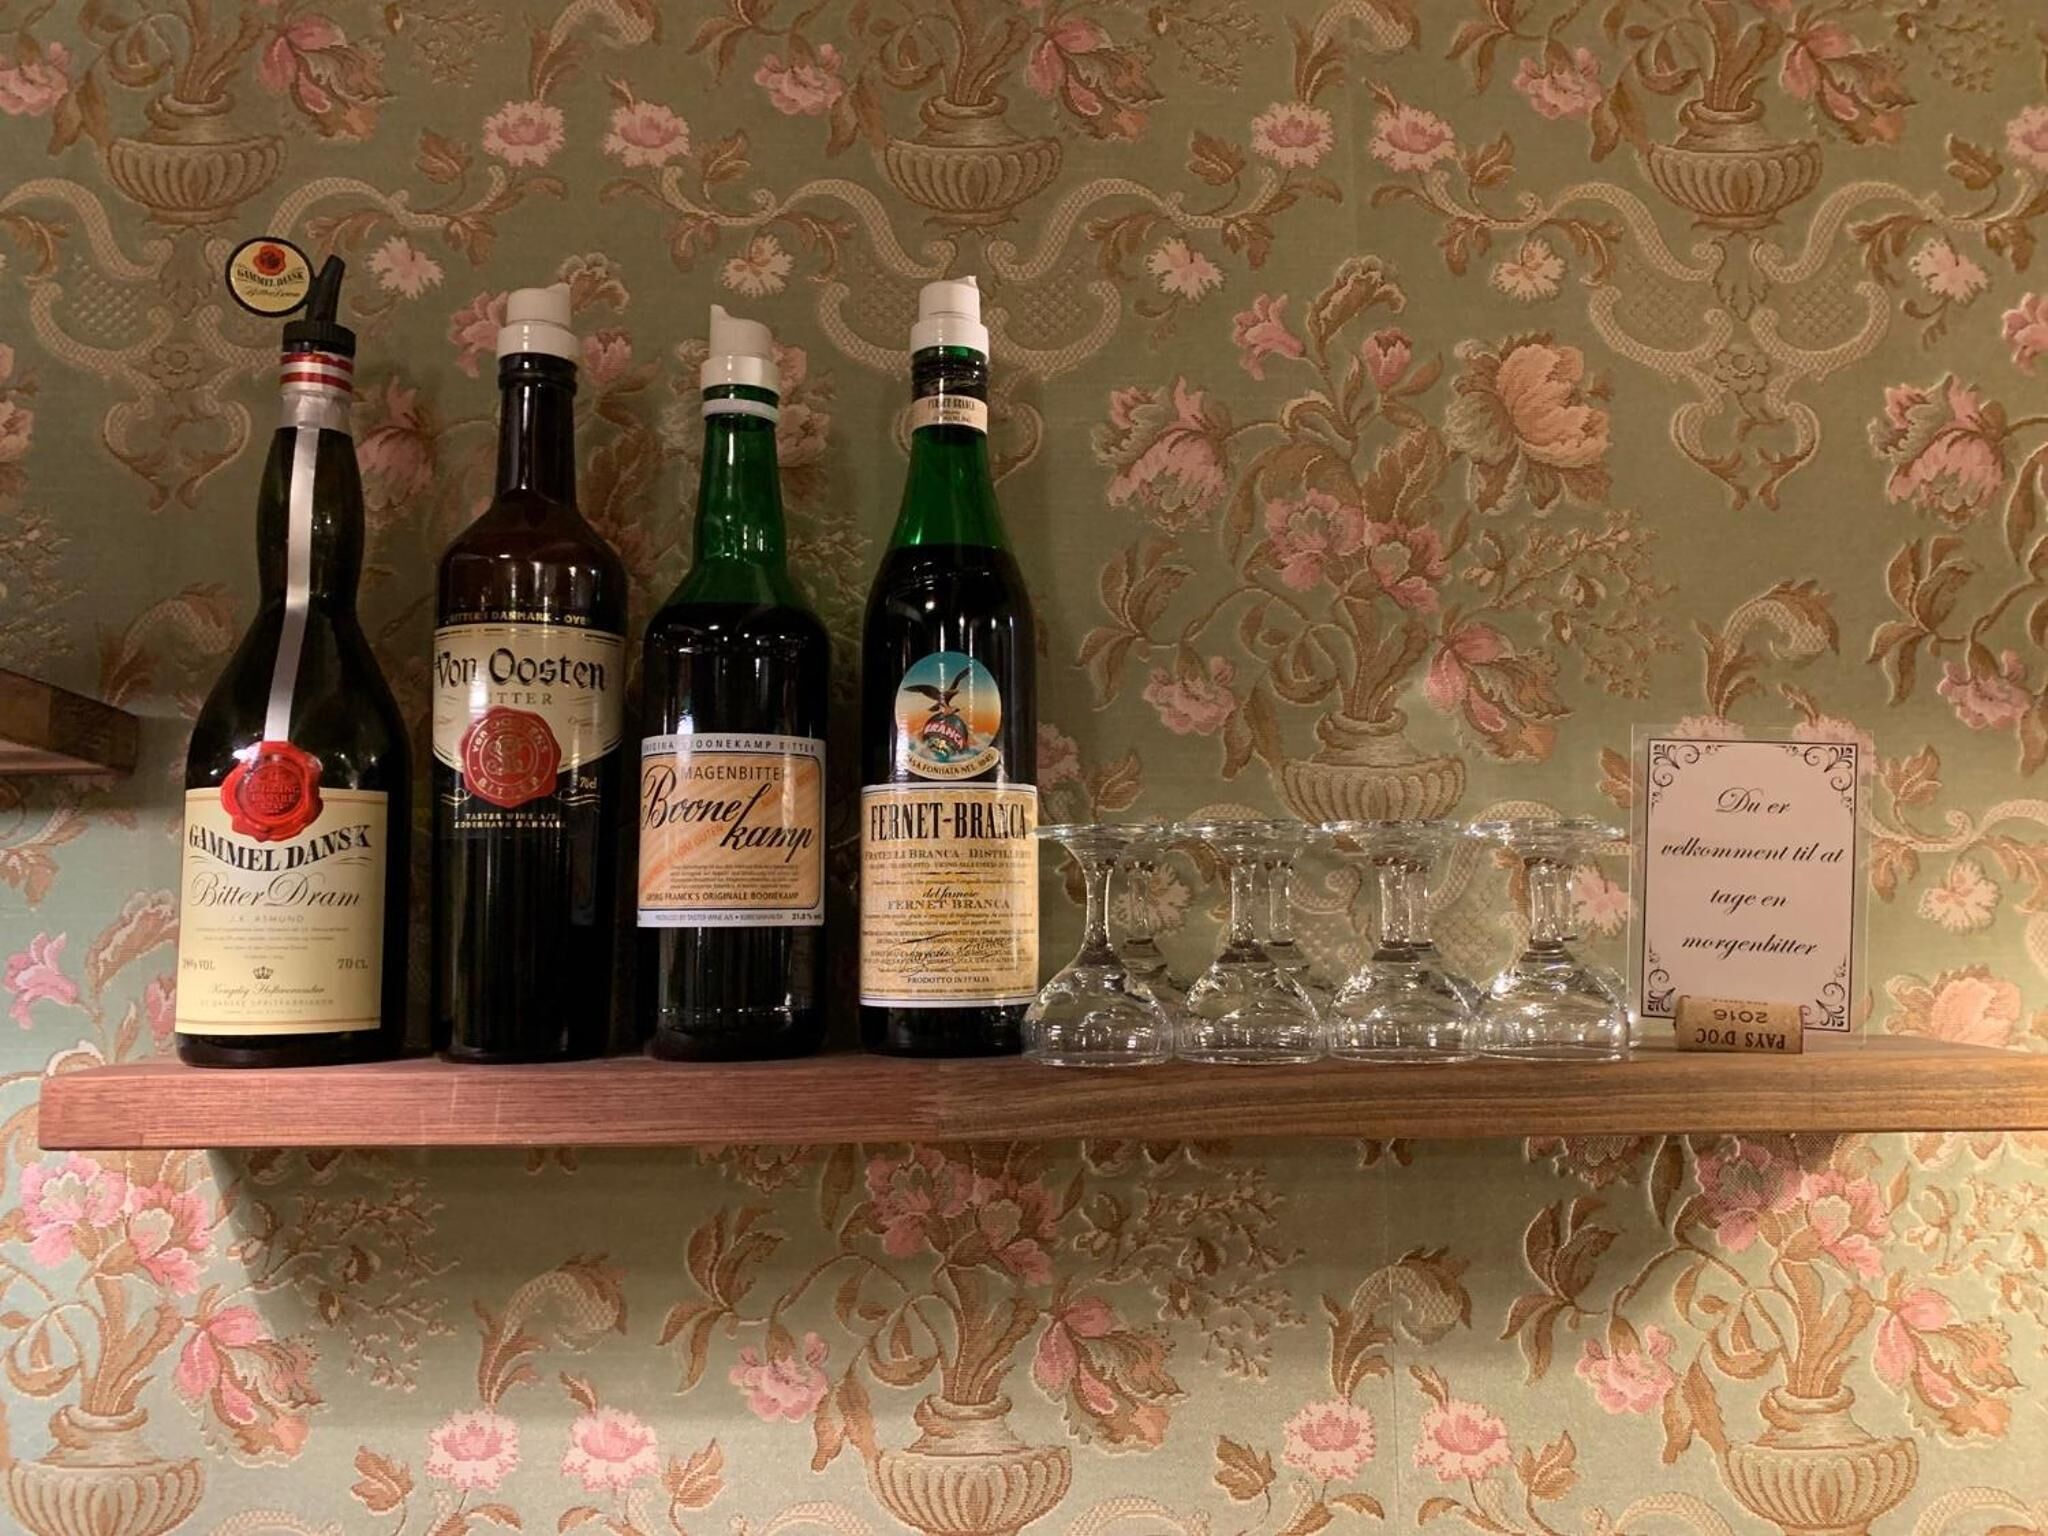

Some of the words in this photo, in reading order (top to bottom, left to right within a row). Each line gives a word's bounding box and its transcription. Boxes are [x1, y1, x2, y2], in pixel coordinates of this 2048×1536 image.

[491, 611, 552, 623] DANMARK
[434, 651, 477, 688] Von
[488, 647, 608, 691] Oosten
[482, 691, 553, 705] ITTER
[693, 737, 772, 749] OONEKAMP
[641, 764, 742, 830] Boone
[1715, 787, 1764, 814] Du
[1767, 802, 1791, 814] er
[719, 782, 814, 863] kamp
[871, 802, 1027, 841] FERNET-BRANCA
[189, 823, 280, 871] GAMMEL
[285, 825, 372, 870] DANSK
[1661, 837, 1788, 860] velkomment
[1792, 843, 1820, 862] til
[1820, 849, 1844, 863] at
[191, 872, 265, 907] Bitter
[264, 872, 361, 907] Dram
[703, 891, 747, 901] ORIGINALE
[751, 891, 799, 901] BOONEKAMP
[1710, 889, 1757, 915] tage
[1760, 895, 1787, 907] en
[887, 900, 949, 911] FERNET
[951, 899, 1011, 910] BRANCA
[1681, 934, 1818, 960] morgenbitter
[1713, 1008, 1768, 1024] 2016
[1745, 1032, 1786, 1050] PAYS
